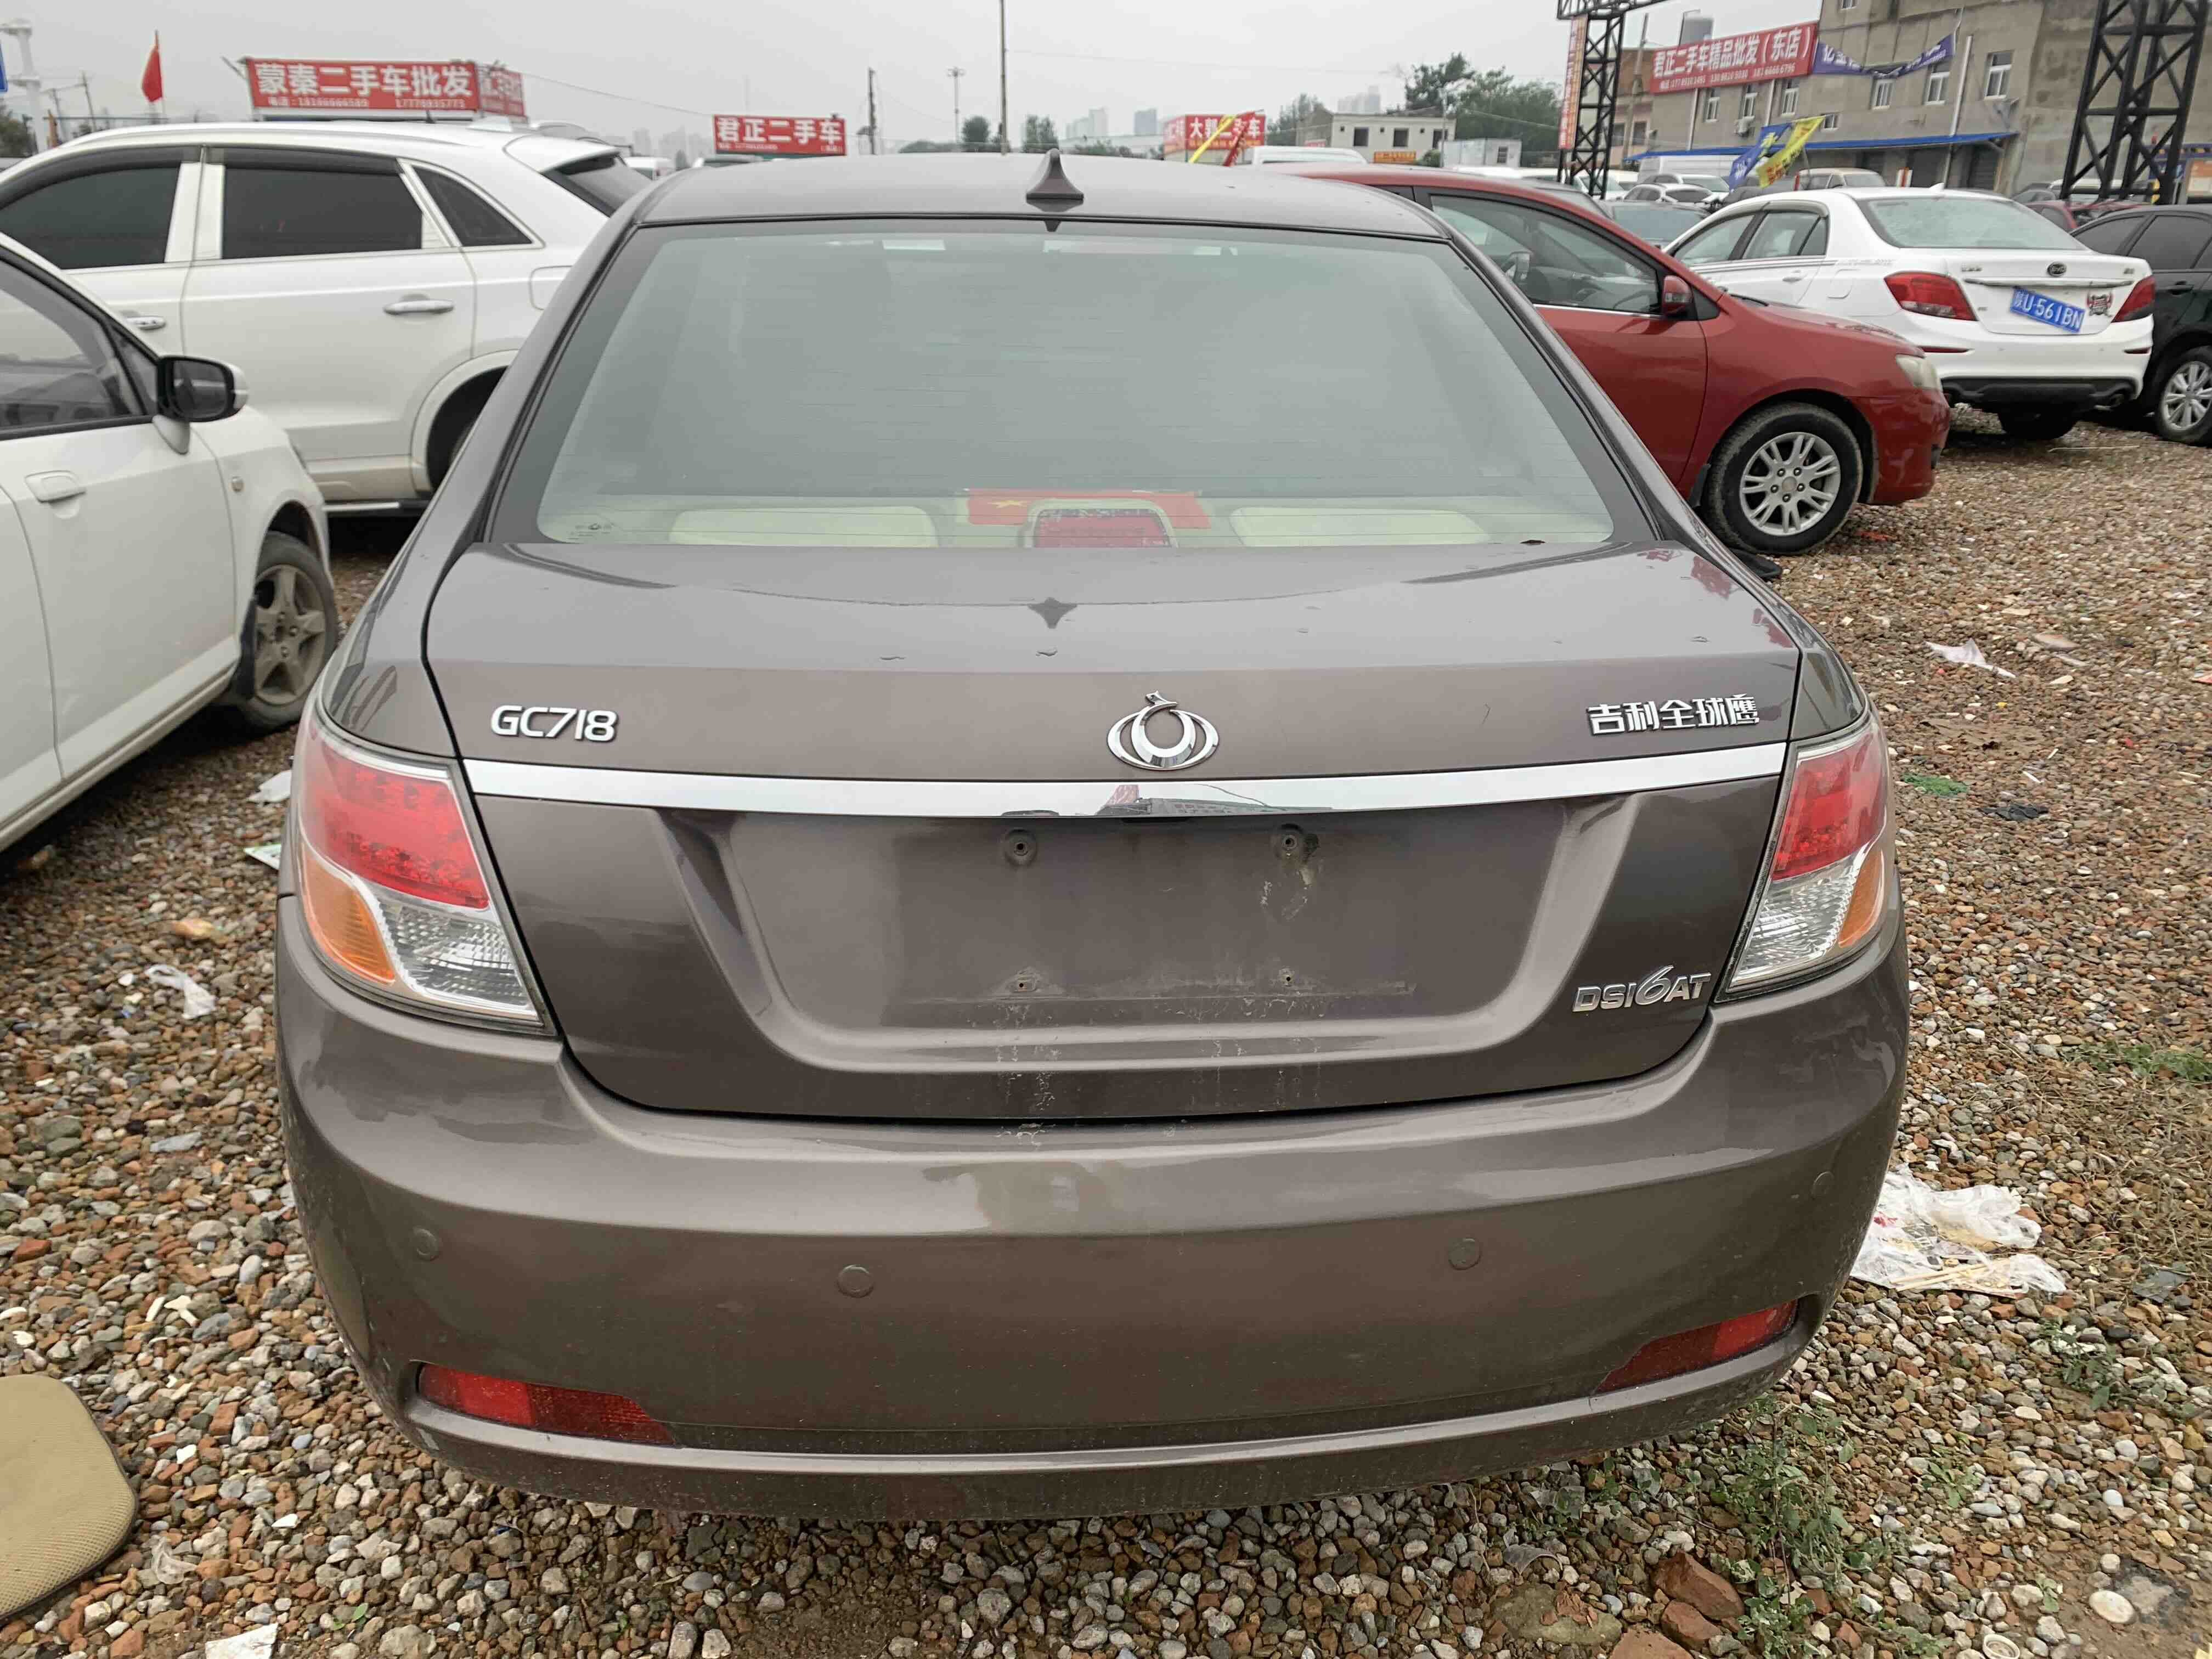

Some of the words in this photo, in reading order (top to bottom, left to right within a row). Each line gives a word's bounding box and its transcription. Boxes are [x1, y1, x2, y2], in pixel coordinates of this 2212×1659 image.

[716, 116, 843, 145] 君正二手车
[491, 705, 618, 742] GC718
[1588, 693, 1759, 735] 吉利全球鹰
